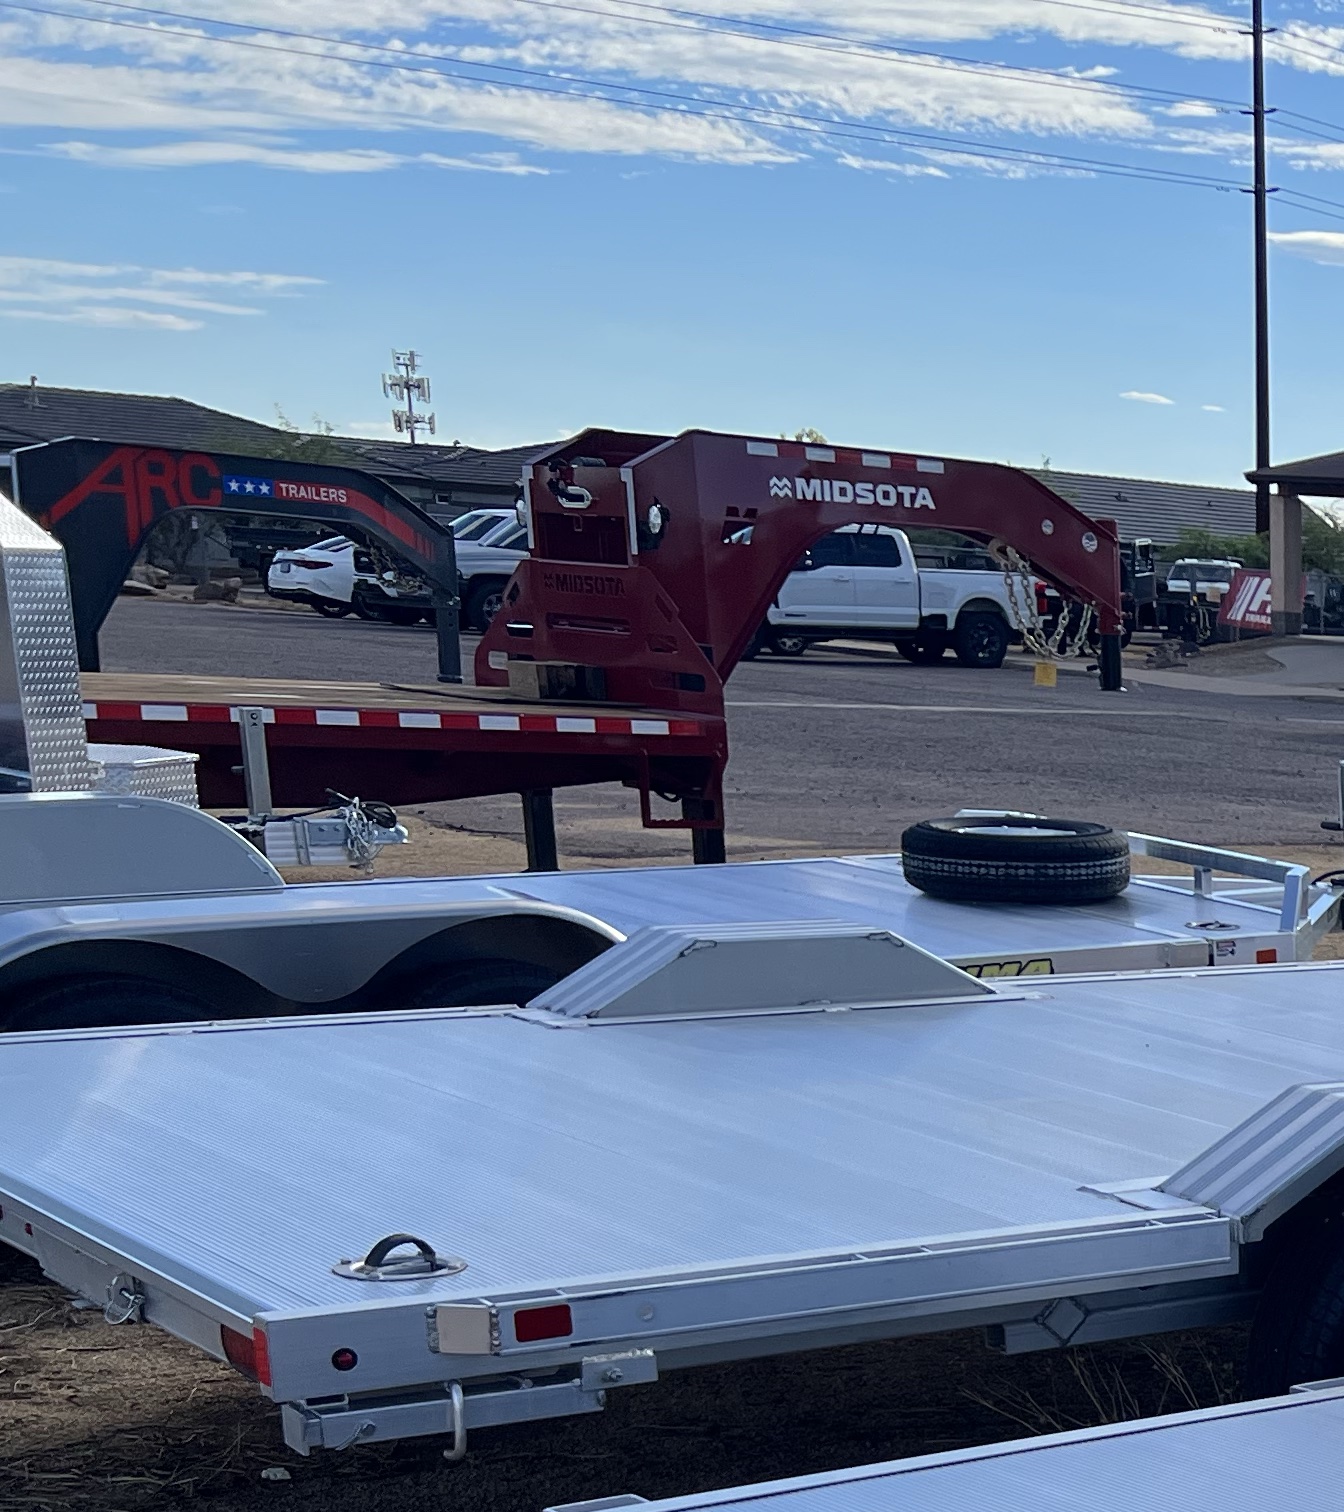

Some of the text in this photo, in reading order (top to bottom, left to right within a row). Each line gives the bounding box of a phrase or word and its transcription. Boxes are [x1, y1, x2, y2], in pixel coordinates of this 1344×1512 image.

[44, 447, 348, 548] ARC TRAILERS
[795, 477, 937, 510] MIDSOTA
[555, 573, 627, 597] MIDSOTA
